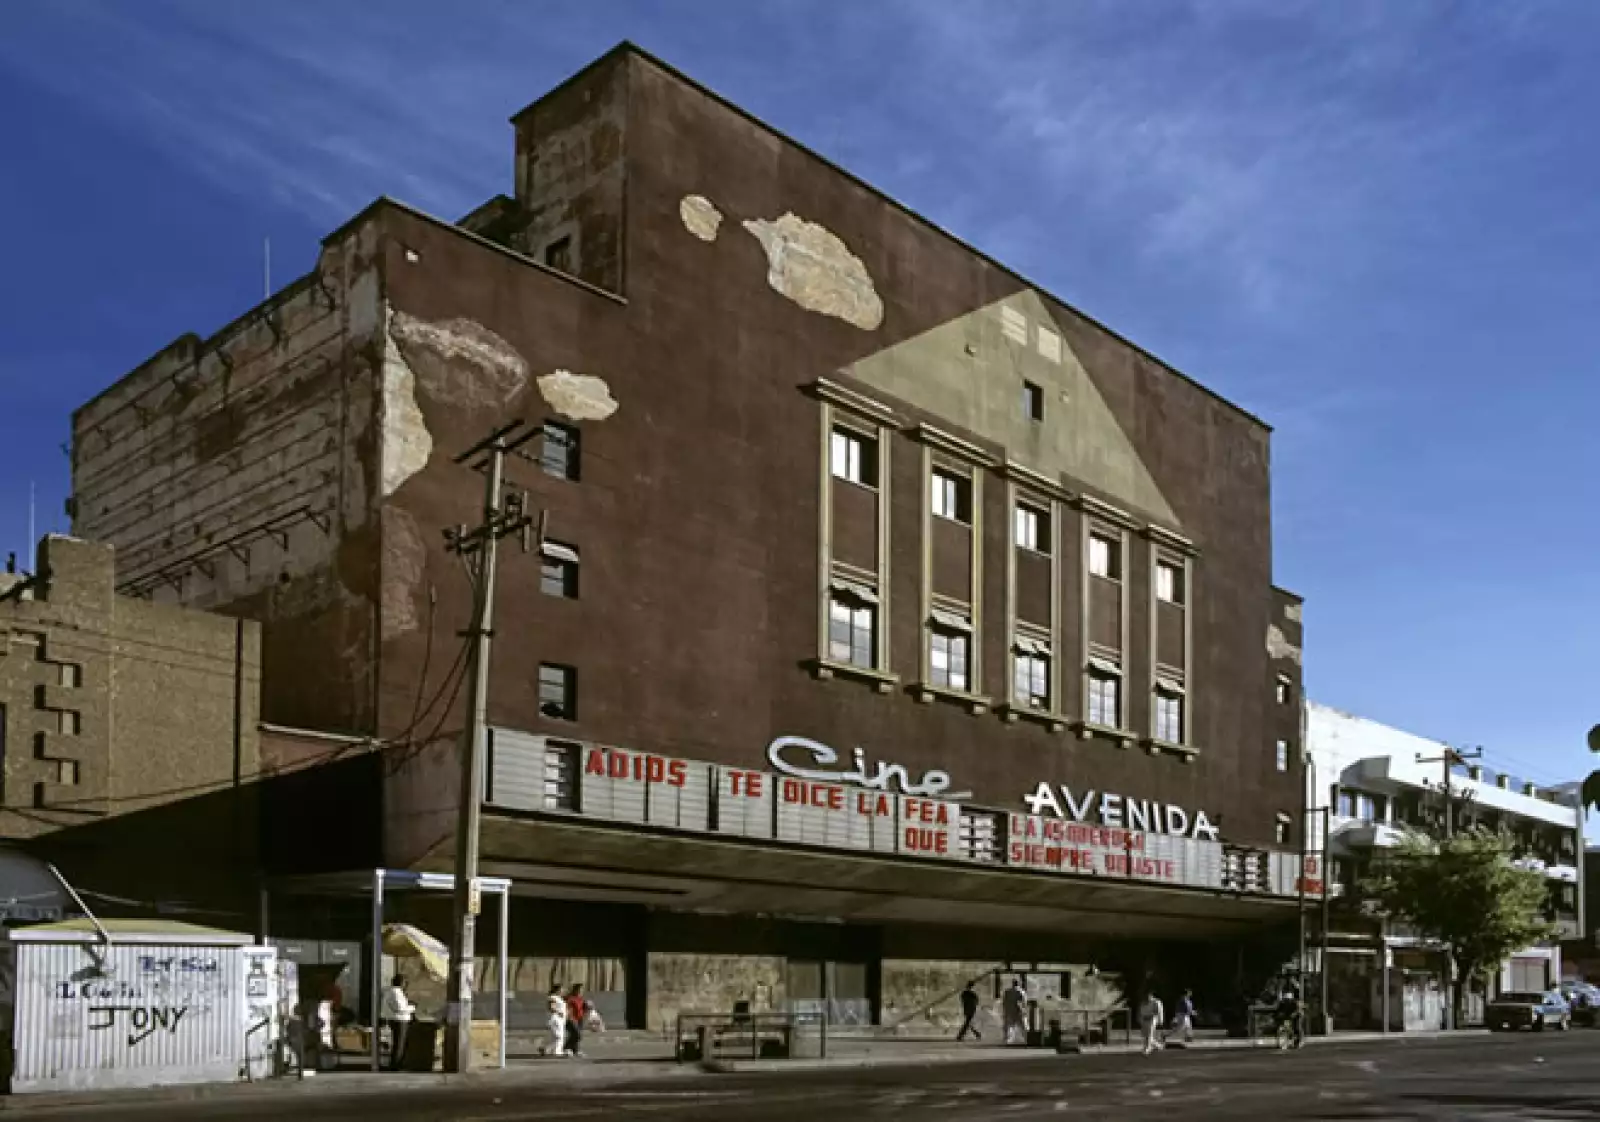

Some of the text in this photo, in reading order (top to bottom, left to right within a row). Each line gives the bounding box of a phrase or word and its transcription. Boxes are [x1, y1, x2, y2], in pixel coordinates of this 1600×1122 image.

[585, 748, 949, 825] ADIOS TE DICE LA FEA
[768, 736, 972, 798] Cine
[1012, 815, 1038, 837] LA
[1024, 781, 1219, 839] AVENIDA
[905, 826, 949, 854] QUE
[1010, 841, 1095, 870] SIEMPRE
